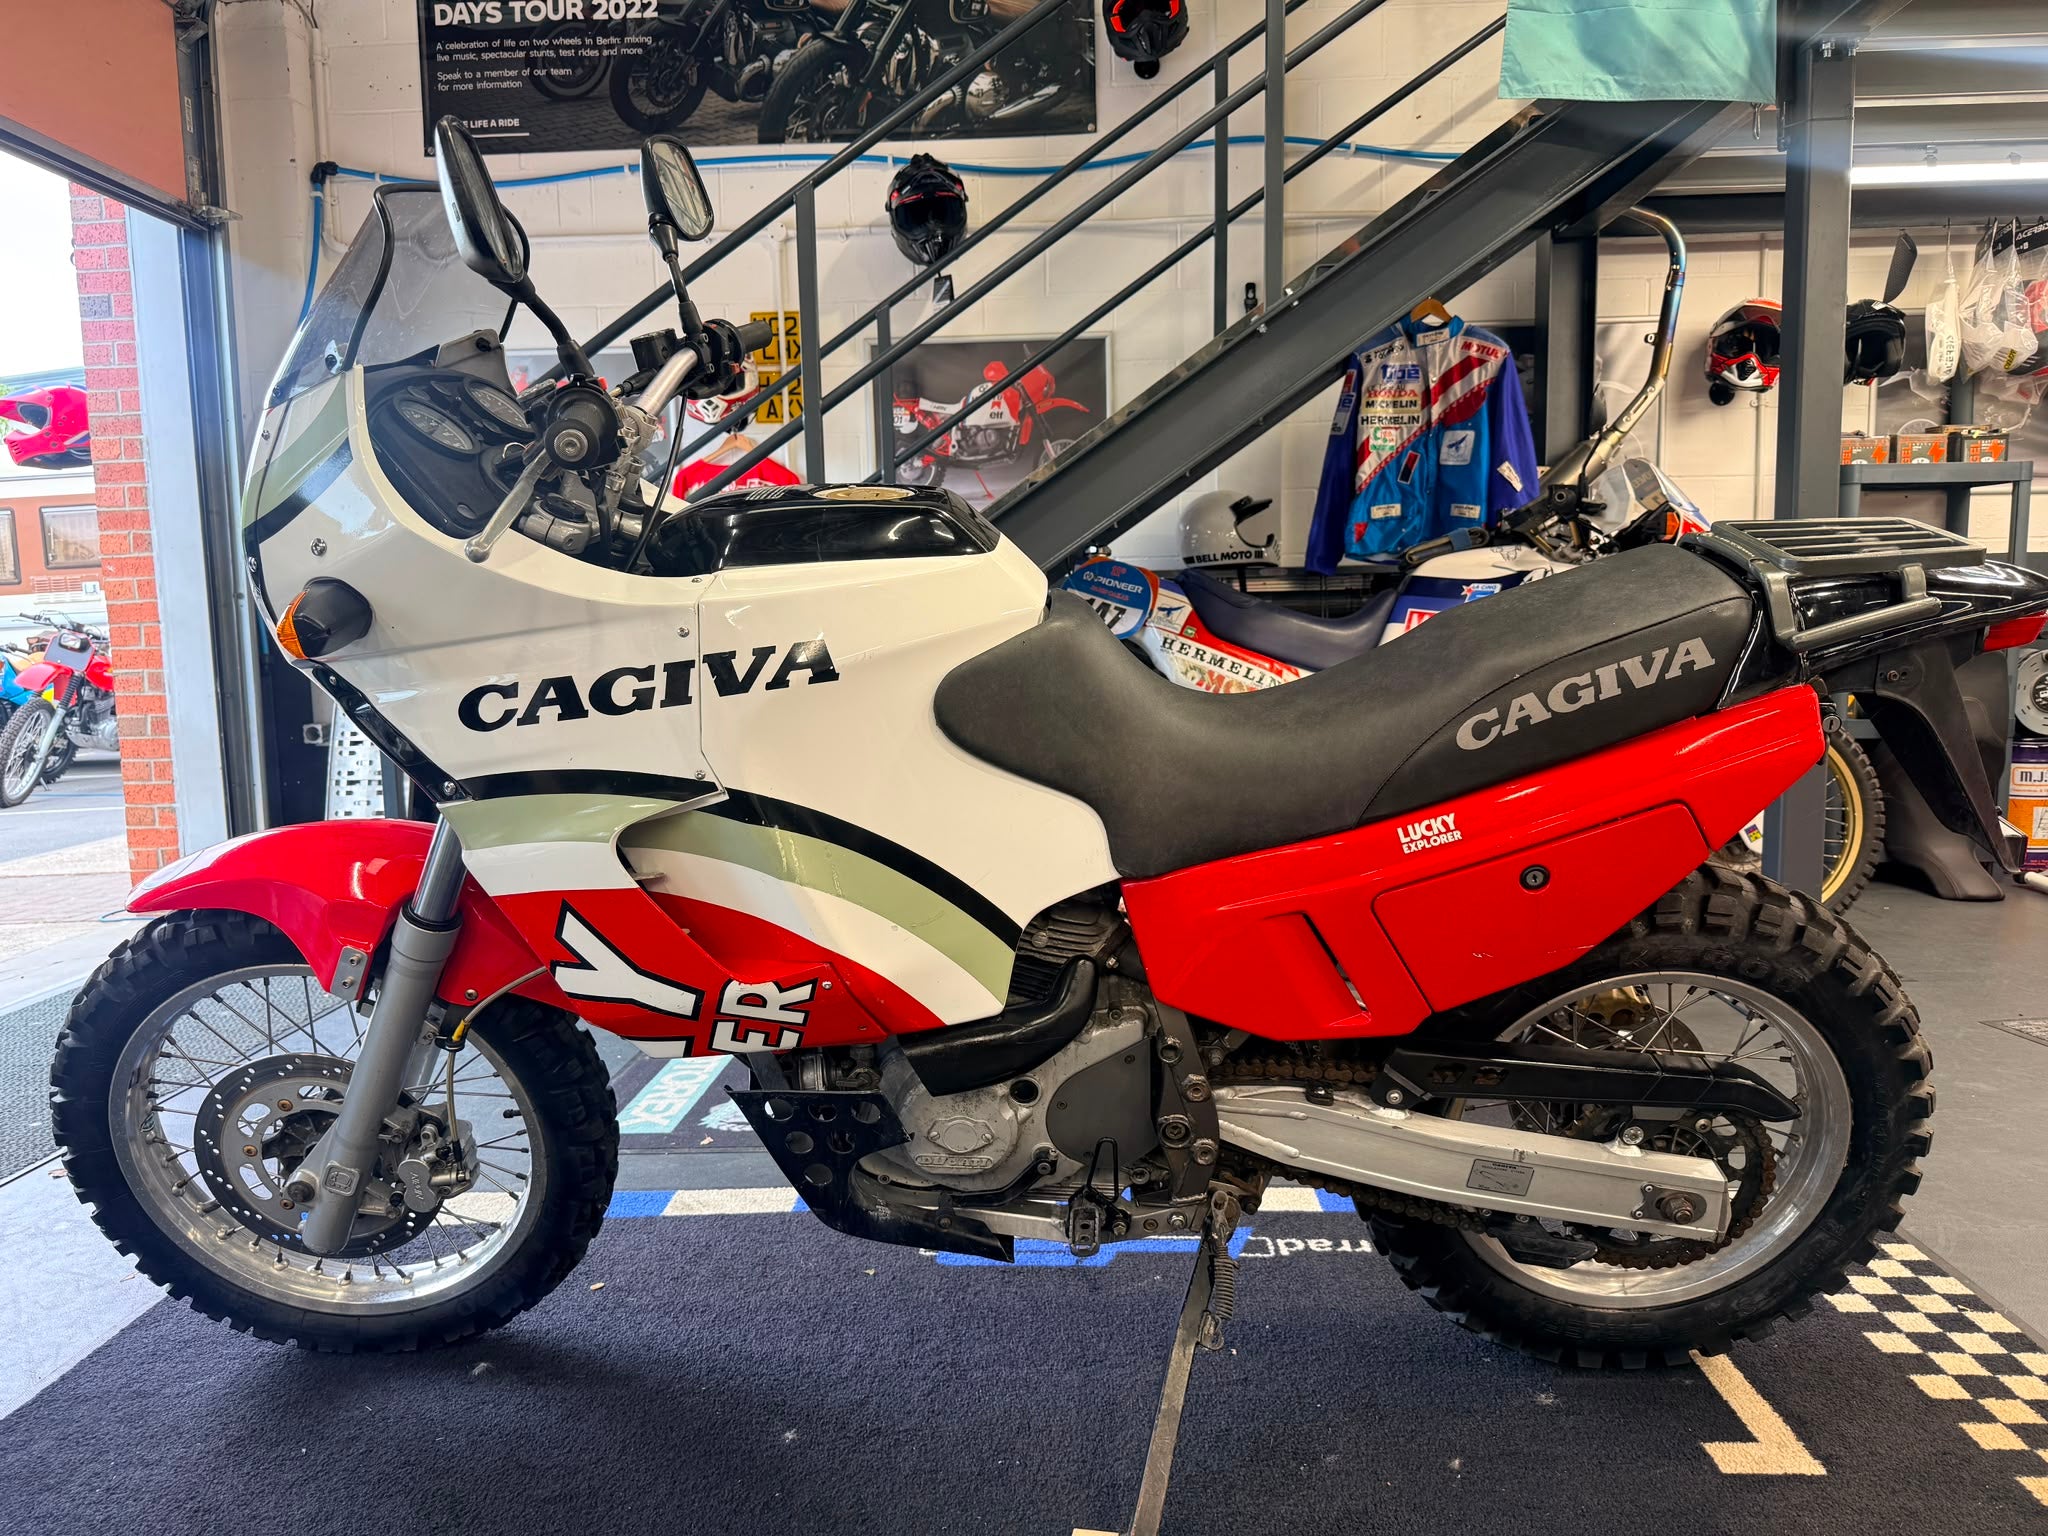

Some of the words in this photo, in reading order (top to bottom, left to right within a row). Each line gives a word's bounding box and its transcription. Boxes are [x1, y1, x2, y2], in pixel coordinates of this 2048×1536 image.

[434, 1, 503, 26] DAYS
[509, 0, 584, 22] TOUR
[591, 0, 659, 20] 2022
[436, 42, 443, 50] A
[445, 40, 489, 51] celebration
[492, 38, 501, 47] of
[503, 38, 516, 47] life
[519, 39, 530, 47] on
[533, 38, 550, 46] two
[552, 36, 582, 46] wheels
[585, 36, 593, 45] in
[624, 35, 653, 46] mixing
[436, 52, 450, 62] live
[452, 52, 478, 61] music,
[481, 50, 526, 61] spectacular
[529, 49, 556, 59] stunts,
[559, 48, 575, 57] test
[578, 48, 600, 57] rides
[602, 47, 618, 56] and
[621, 47, 643, 56] more
[436, 69, 461, 82] Speak
[464, 71, 473, 79] to
[484, 68, 518, 79] member
[521, 68, 530, 77] of
[550, 67, 572, 76] team
[437, 82, 450, 92] for
[453, 82, 474, 91] more
[476, 80, 523, 90] information
[470, 119, 489, 129] LIFE
[490, 119, 497, 128] A
[498, 118, 520, 127] RIDE
[989, 410, 1004, 420] elf
[1360, 415, 1420, 426] HERMELIN
[1195, 553, 1219, 563] BELL
[1220, 550, 1251, 562] MOTO
[1093, 575, 1144, 595] PIONEER
[1088, 598, 1127, 629] 47
[457, 638, 840, 733] CAGIVA
[1455, 637, 1715, 751] CAGIVA
[1396, 813, 1456, 843] LUCKY
[1402, 830, 1463, 854] EXPLORER
[620, 1058, 722, 1127] TOREX
[920, 1156, 990, 1167] DUCATI
[1275, 1237, 1373, 1256] rrad
